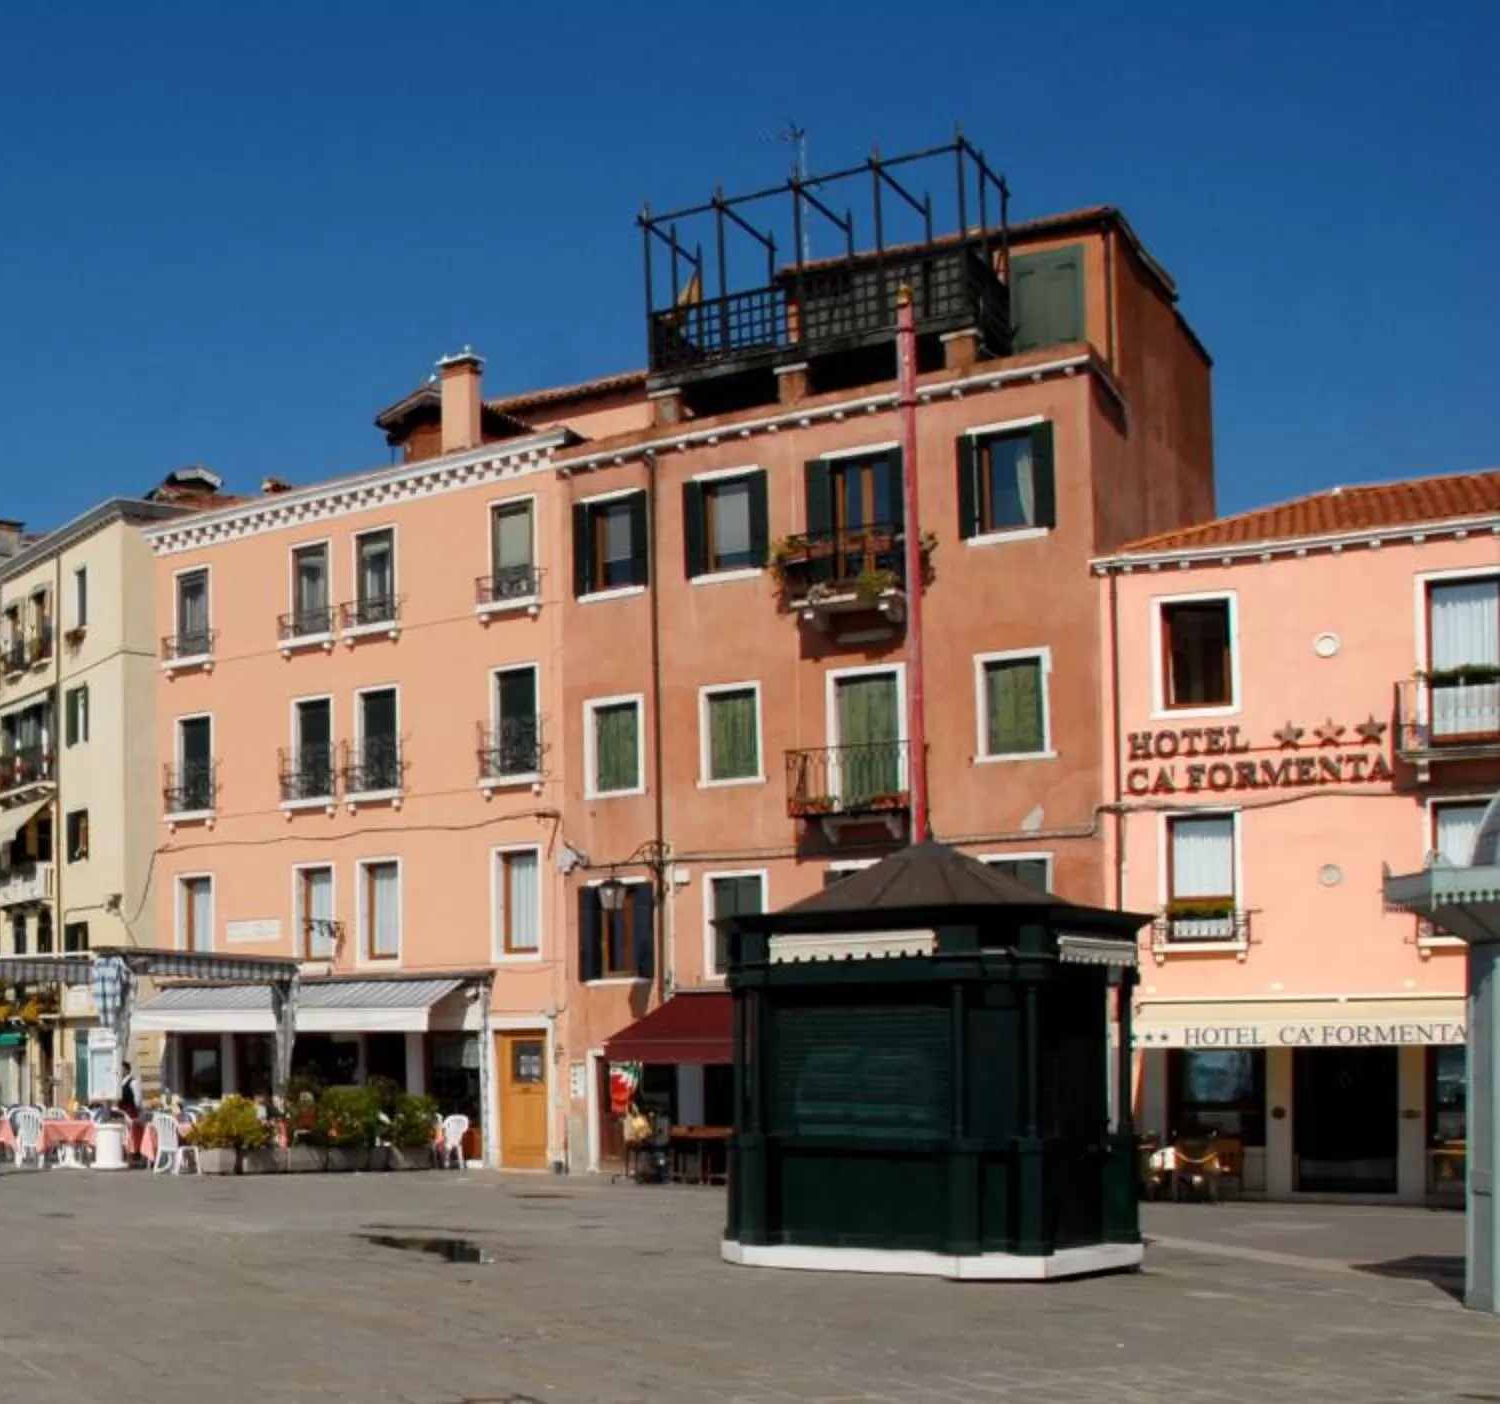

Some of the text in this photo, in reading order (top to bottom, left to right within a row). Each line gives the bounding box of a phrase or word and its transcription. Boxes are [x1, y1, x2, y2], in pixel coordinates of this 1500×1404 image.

[1127, 726, 1249, 760] HOTEL
[1126, 753, 1394, 795] CA' FORMENTA
[1184, 1026, 1266, 1046] HOTEL
[1322, 1024, 1467, 1045] FORMENTA
